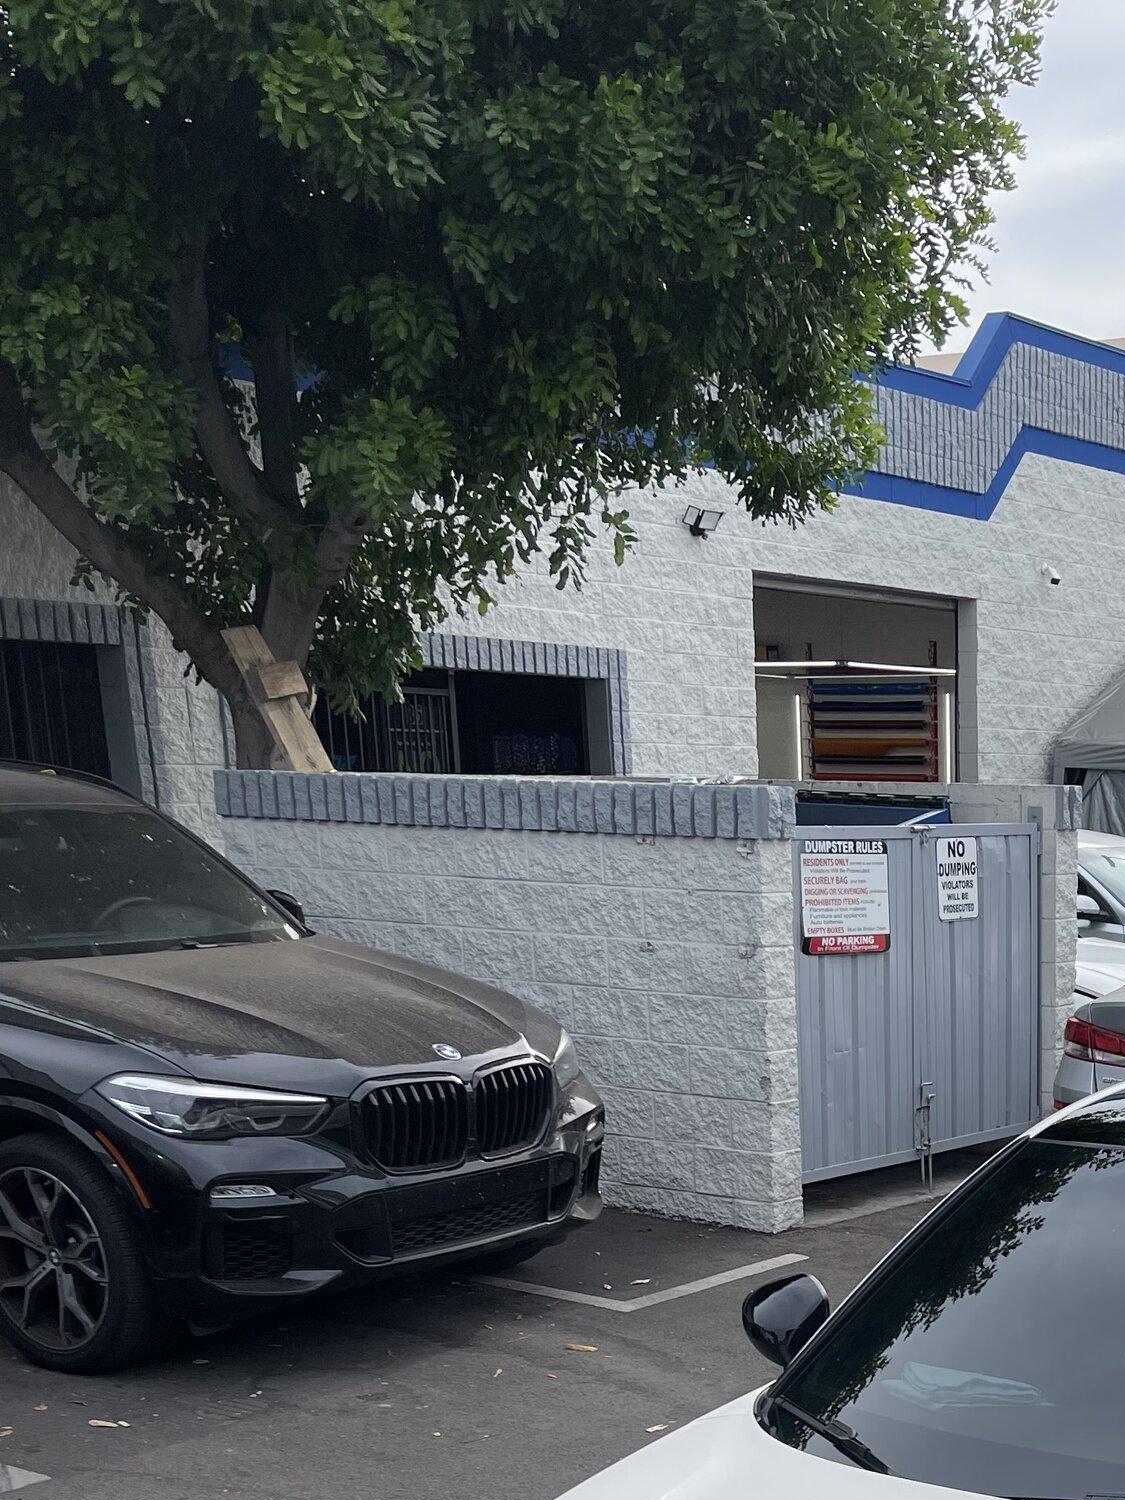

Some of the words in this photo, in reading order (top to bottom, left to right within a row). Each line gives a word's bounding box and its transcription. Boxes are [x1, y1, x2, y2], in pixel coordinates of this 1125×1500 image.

[805, 840, 854, 853] DUMPSTER
[856, 841, 884, 853] RULES
[947, 840, 965, 858] NO
[803, 858, 834, 867] RESIDENTS
[835, 858, 849, 866] ONLY
[938, 862, 976, 877] DUMPING
[803, 876, 835, 885] SECURELY
[836, 876, 848, 885] BAG
[941, 880, 974, 890] VIOLATORS
[947, 893, 960, 901] WILL
[961, 892, 969, 900] BE
[805, 898, 842, 906] PROHIBITED
[843, 898, 860, 906] ITEMS
[943, 903, 975, 914] PROSECUTED
[821, 937, 835, 946] NO
[837, 936, 875, 946] PARKING
